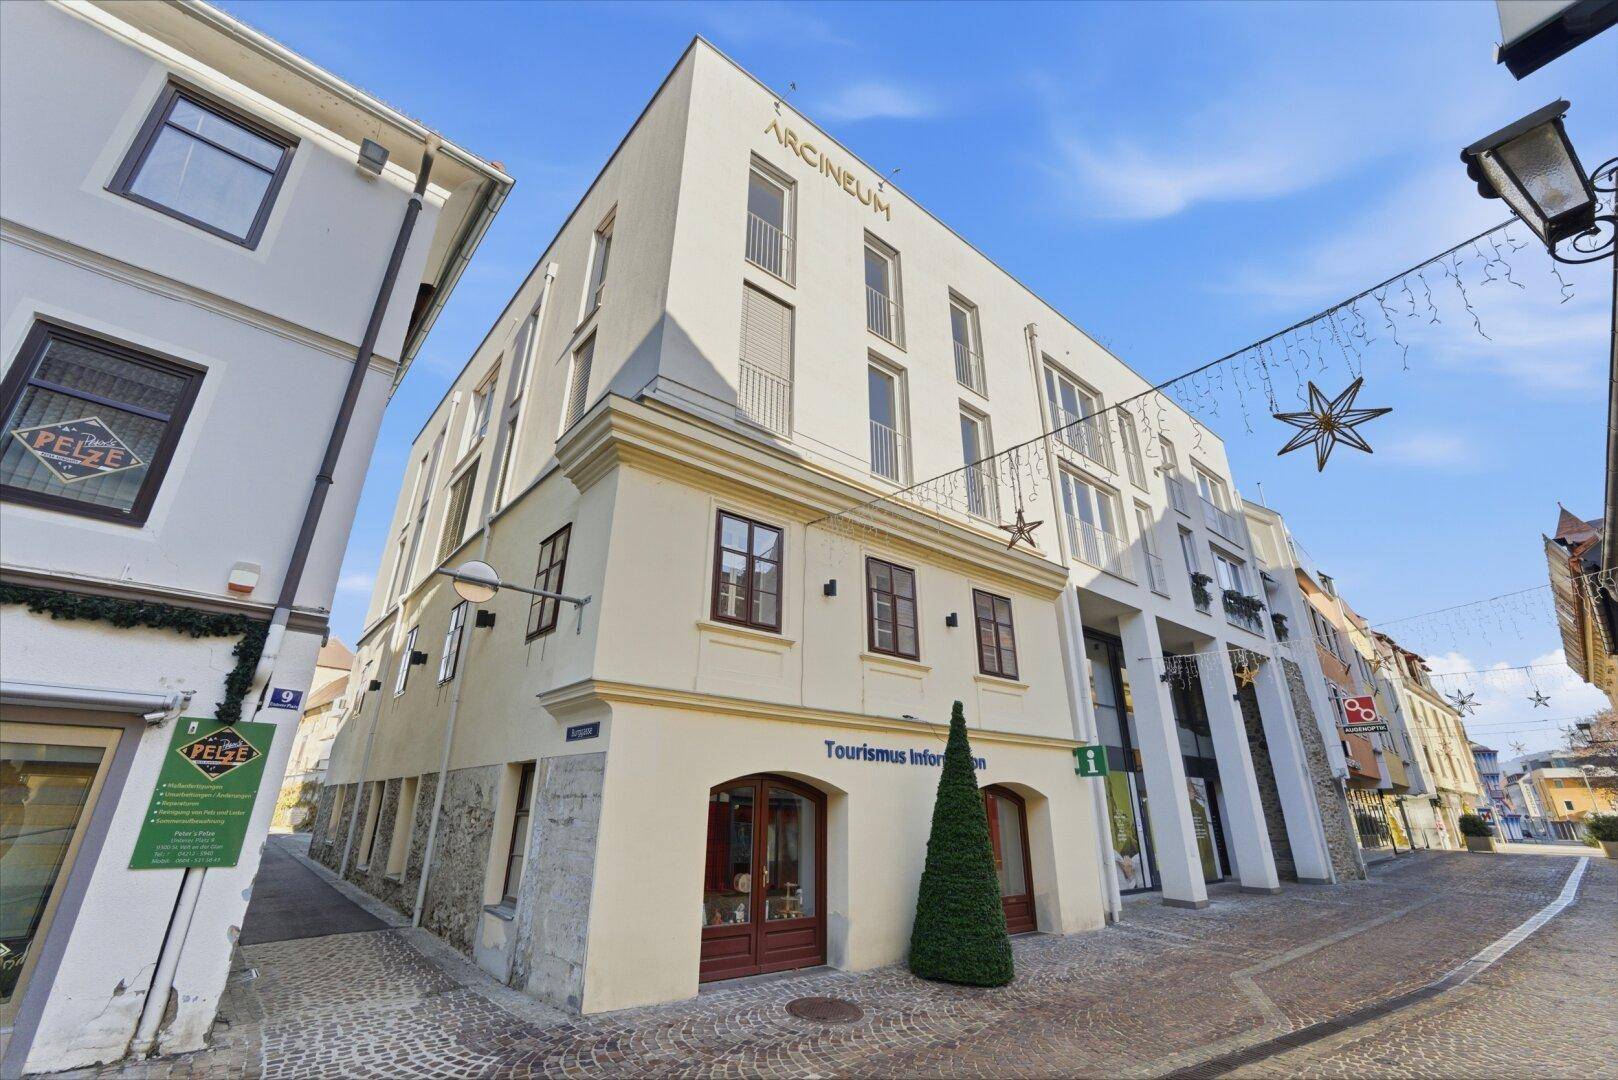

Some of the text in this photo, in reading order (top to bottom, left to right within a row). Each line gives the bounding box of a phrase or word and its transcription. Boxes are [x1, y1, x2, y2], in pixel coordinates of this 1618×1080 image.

[763, 119, 891, 222] ARCINEUM
[32, 430, 125, 468] PELZE
[281, 690, 294, 703] 9
[1345, 725, 1387, 733] AUGENOPTIK
[190, 744, 249, 766] PELZE
[824, 739, 987, 770] Tourismus Inforon
